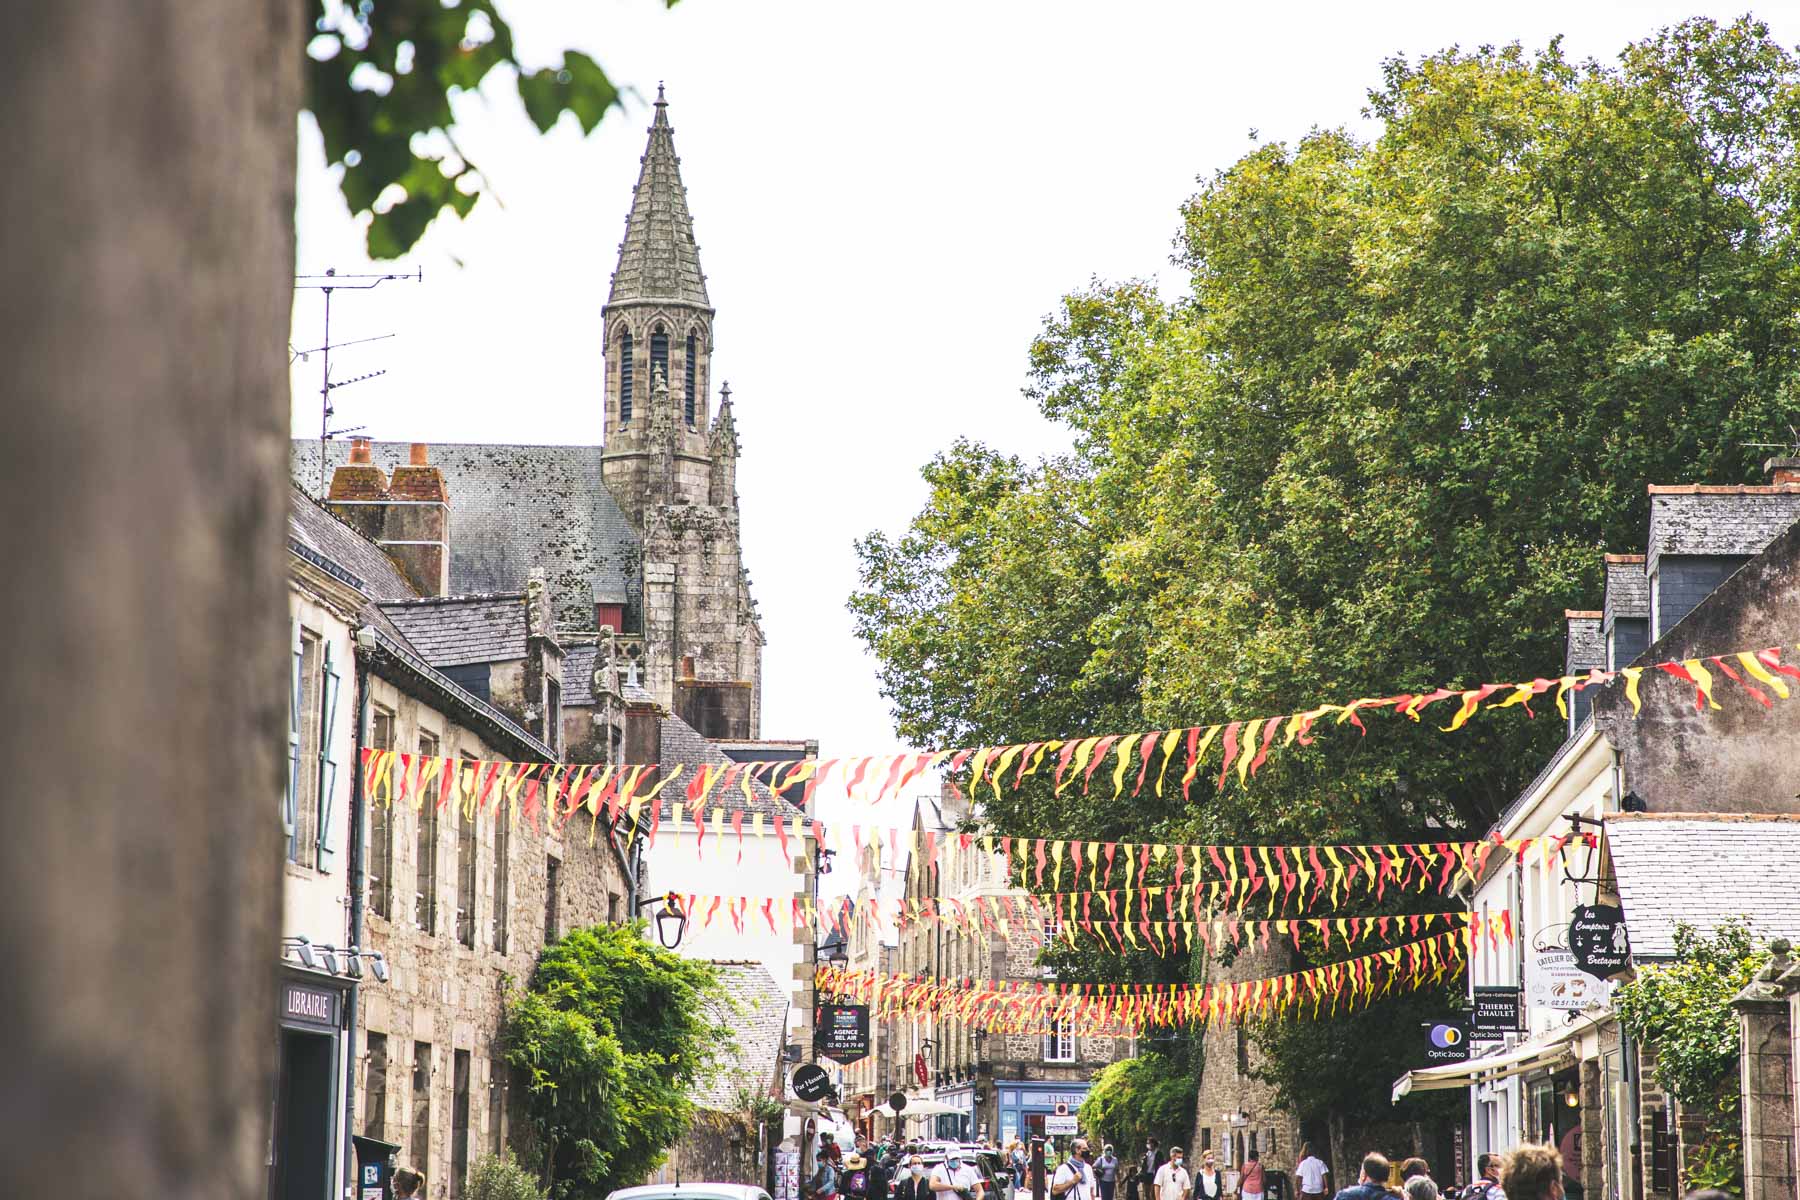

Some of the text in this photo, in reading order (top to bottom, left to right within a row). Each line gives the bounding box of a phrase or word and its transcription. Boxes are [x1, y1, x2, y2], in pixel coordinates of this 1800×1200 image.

[1575, 920, 1610, 931] Comptoirs
[1592, 933, 1601, 941] du
[1592, 944, 1608, 953] Sud
[1587, 954, 1621, 967] Bretagne
[288, 990, 328, 1018] LIBRAIRIE
[1478, 1002, 1514, 1010] THIERRY
